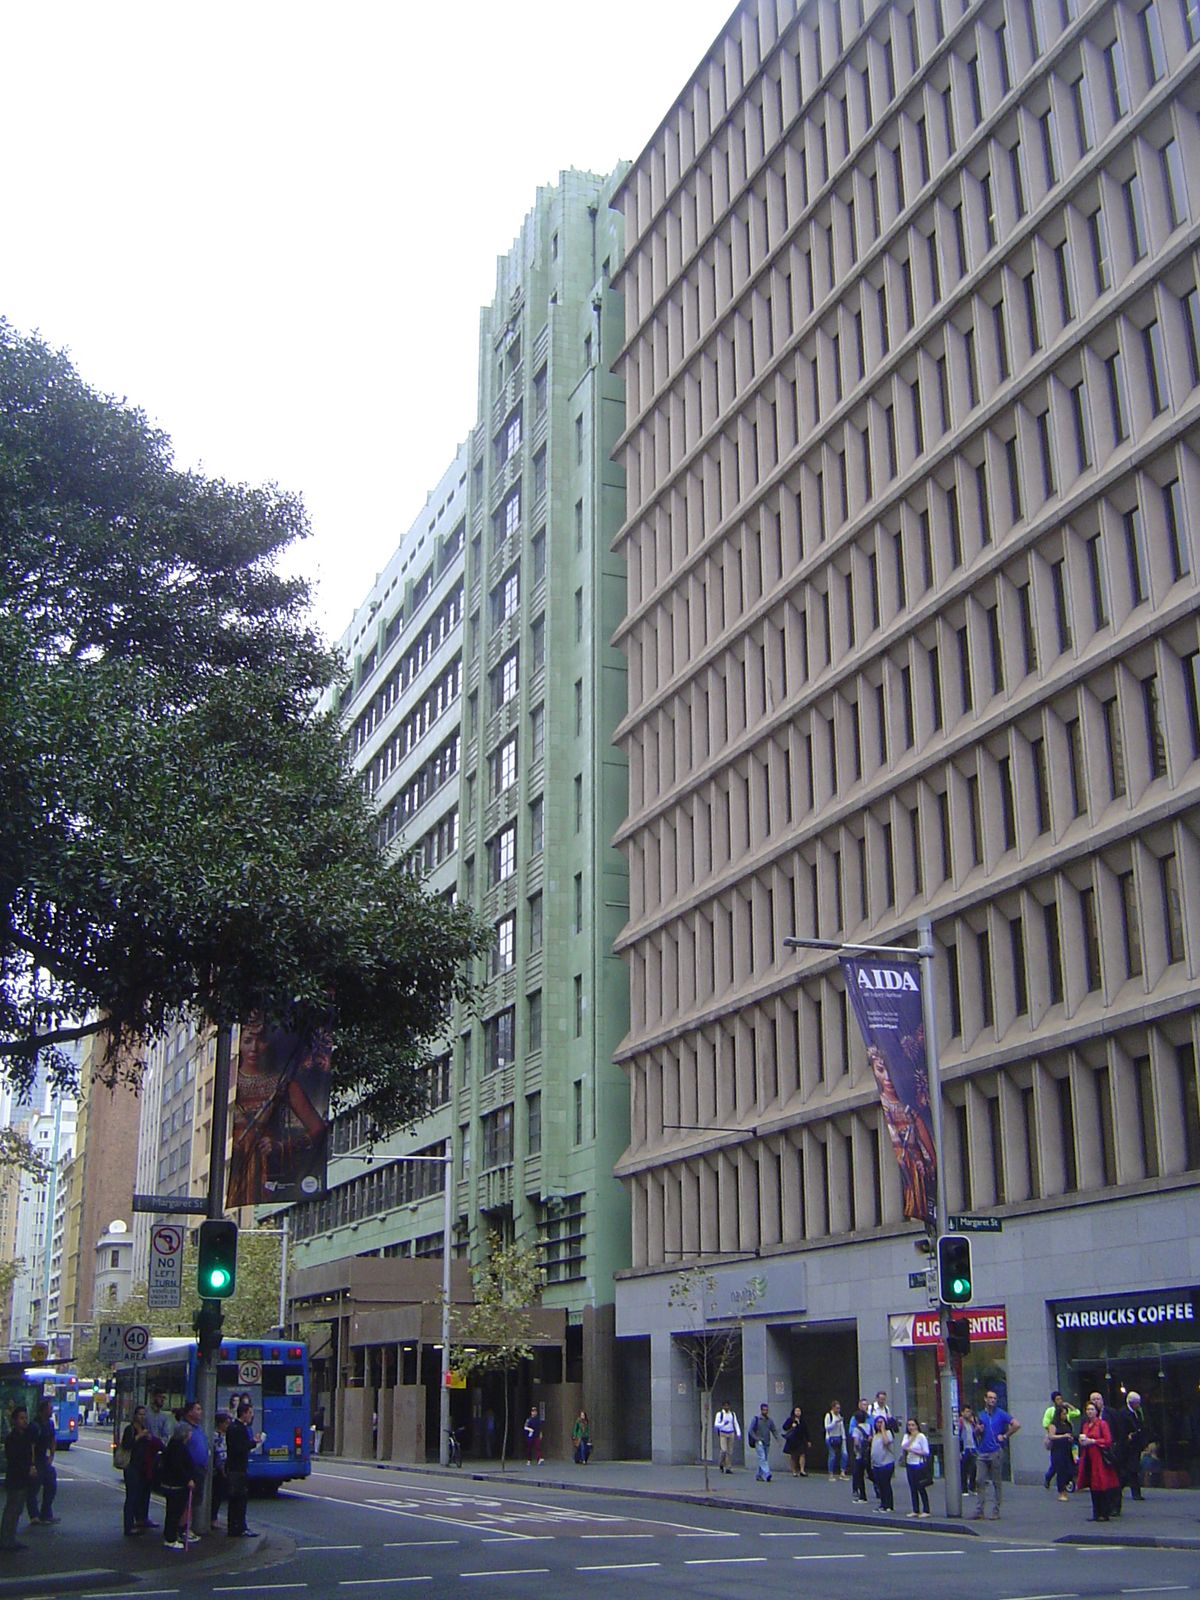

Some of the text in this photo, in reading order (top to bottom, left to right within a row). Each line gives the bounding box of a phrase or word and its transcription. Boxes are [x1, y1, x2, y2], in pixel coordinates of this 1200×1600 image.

[857, 968, 919, 991] AIDA
[152, 1197, 203, 1209] Margaret St
[960, 1217, 999, 1228] Margaret St
[158, 1258, 175, 1268] NO
[155, 1270, 175, 1278] LEFT
[155, 1279, 177, 1288] TURN
[1056, 1303, 1194, 1329] STARBUCKS COFFEE
[968, 1316, 1005, 1333] ENTRE
[128, 1333, 145, 1345] 40
[243, 1367, 258, 1378] 40
